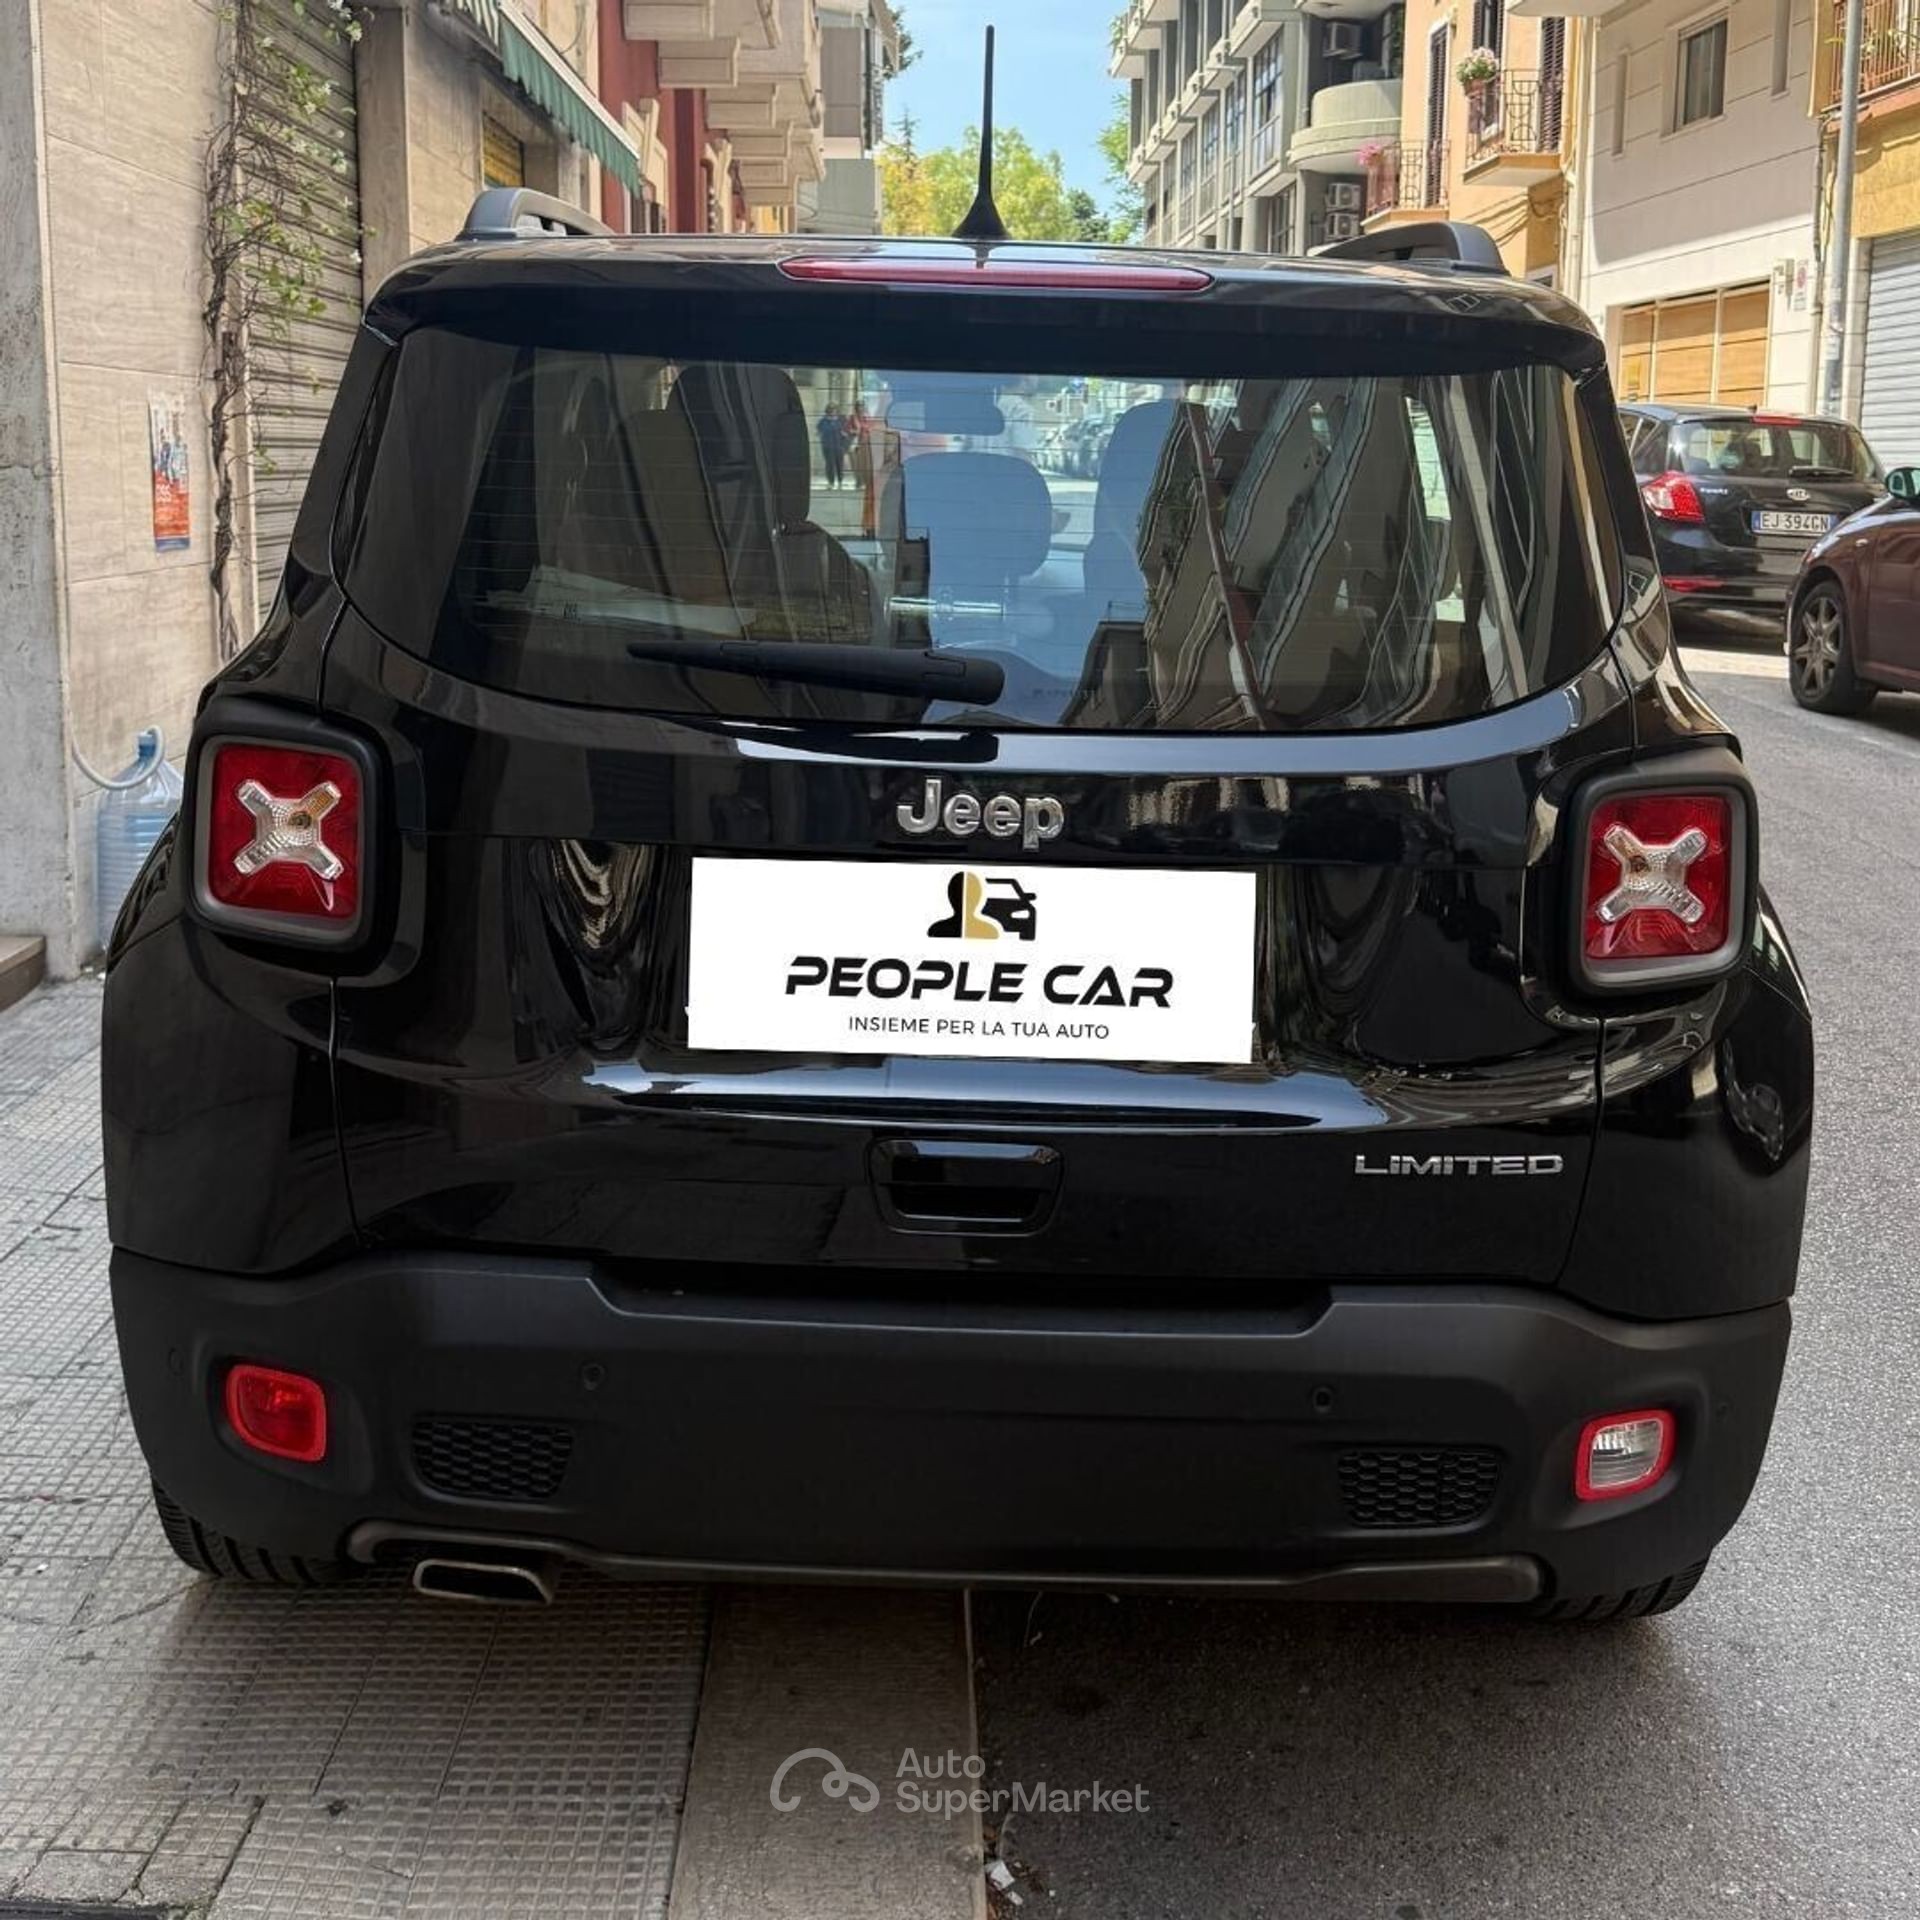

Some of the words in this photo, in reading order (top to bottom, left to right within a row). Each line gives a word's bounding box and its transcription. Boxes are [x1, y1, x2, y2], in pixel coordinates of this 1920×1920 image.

[1761, 513, 1780, 528] EJ
[896, 778, 1065, 851] Jeep
[1354, 1154, 1564, 1176] LIMITED
